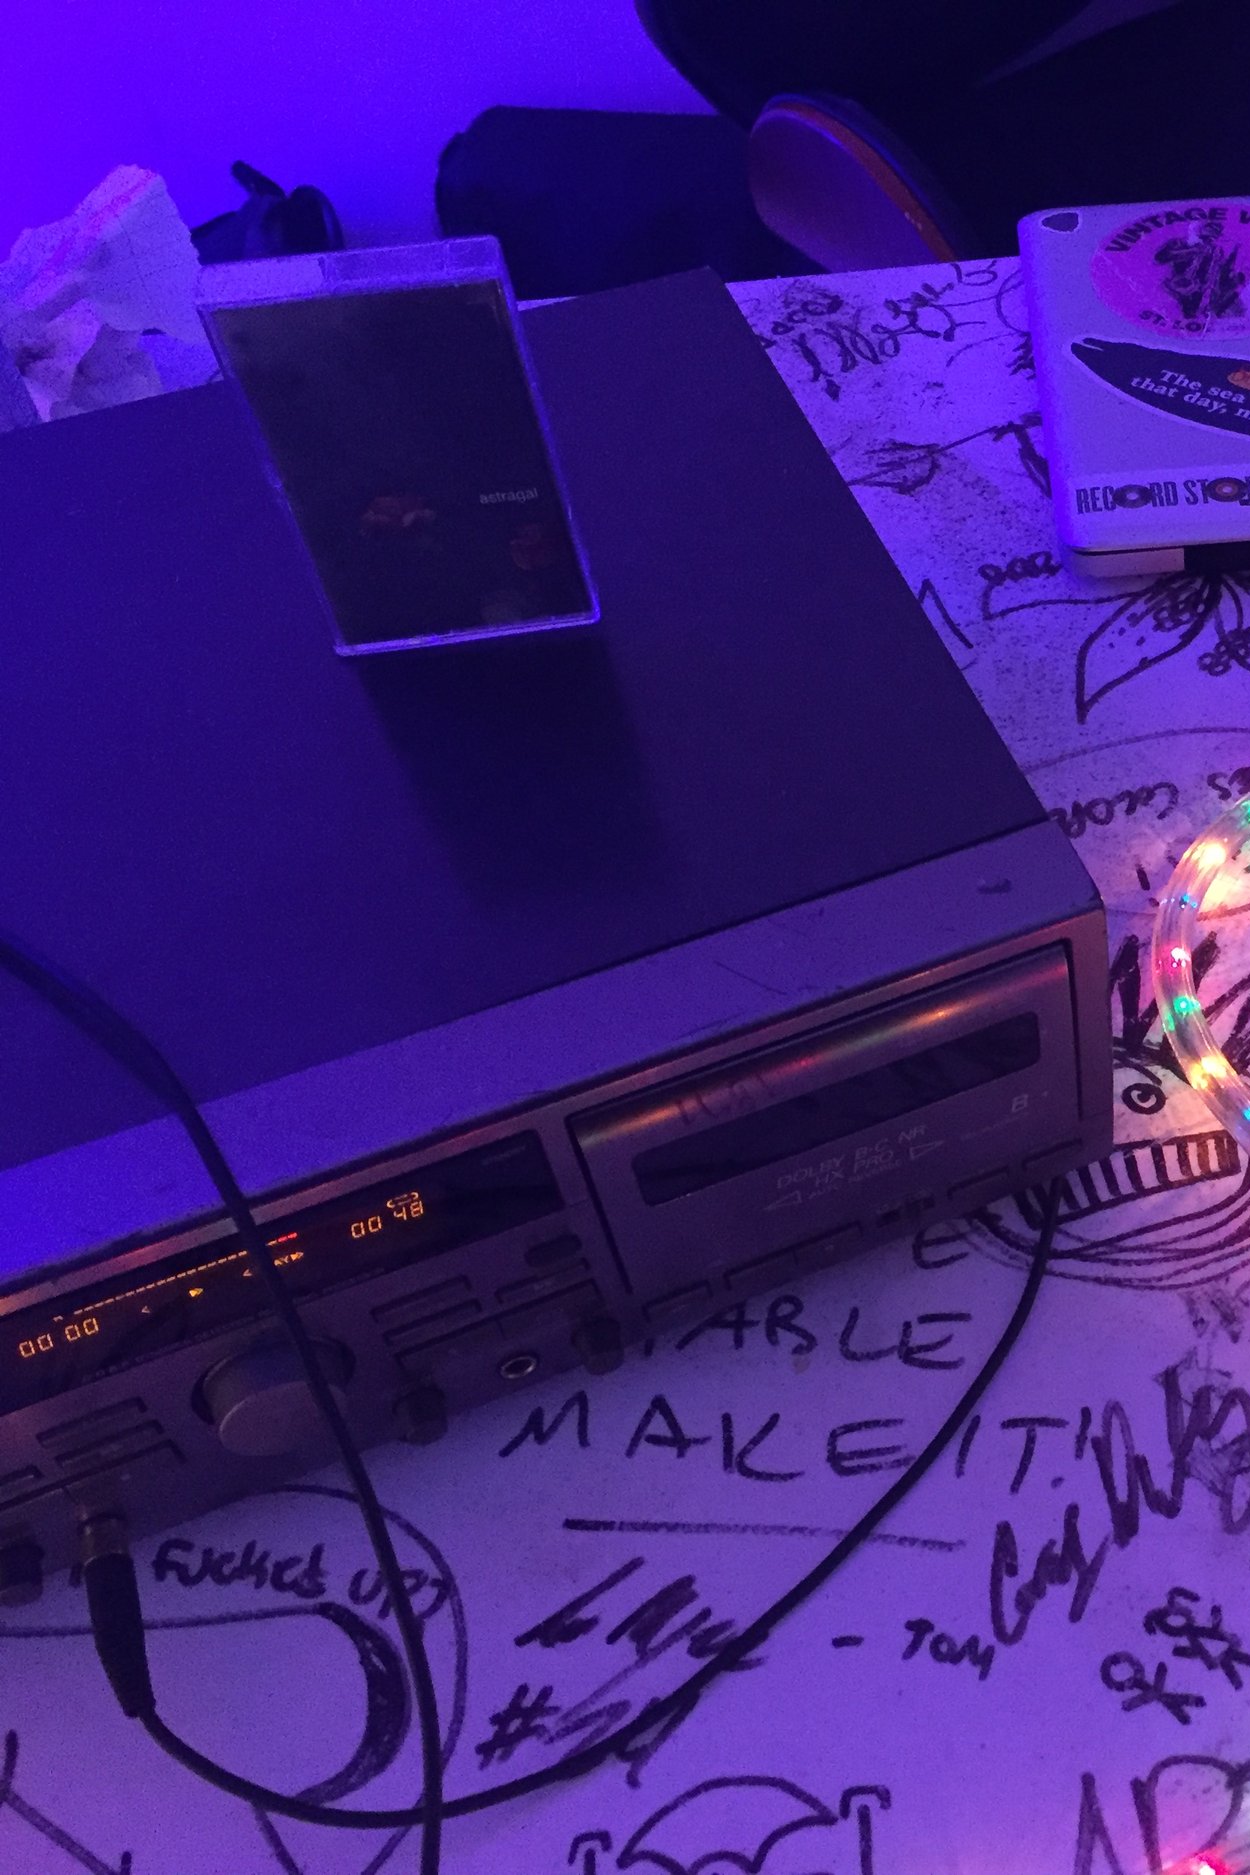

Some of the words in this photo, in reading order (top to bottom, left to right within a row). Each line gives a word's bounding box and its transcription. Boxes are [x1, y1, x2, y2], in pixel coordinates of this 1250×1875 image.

[1105, 207, 1228, 251] VINTAGE
[1130, 377, 1178, 398] that
[1183, 392, 1228, 414] day,
[1159, 370, 1203, 390] The
[1208, 384, 1246, 404] sea
[1075, 480, 1179, 515] RECORD
[1012, 1094, 1028, 1112] B
[776, 1154, 846, 1189] DOLBY
[898, 1125, 926, 1144] NR
[814, 1169, 846, 1188] HX
[854, 1150, 893, 1174] PRO
[643, 1296, 972, 1370] ABLE
[501, 1391, 916, 1481] MAKE
